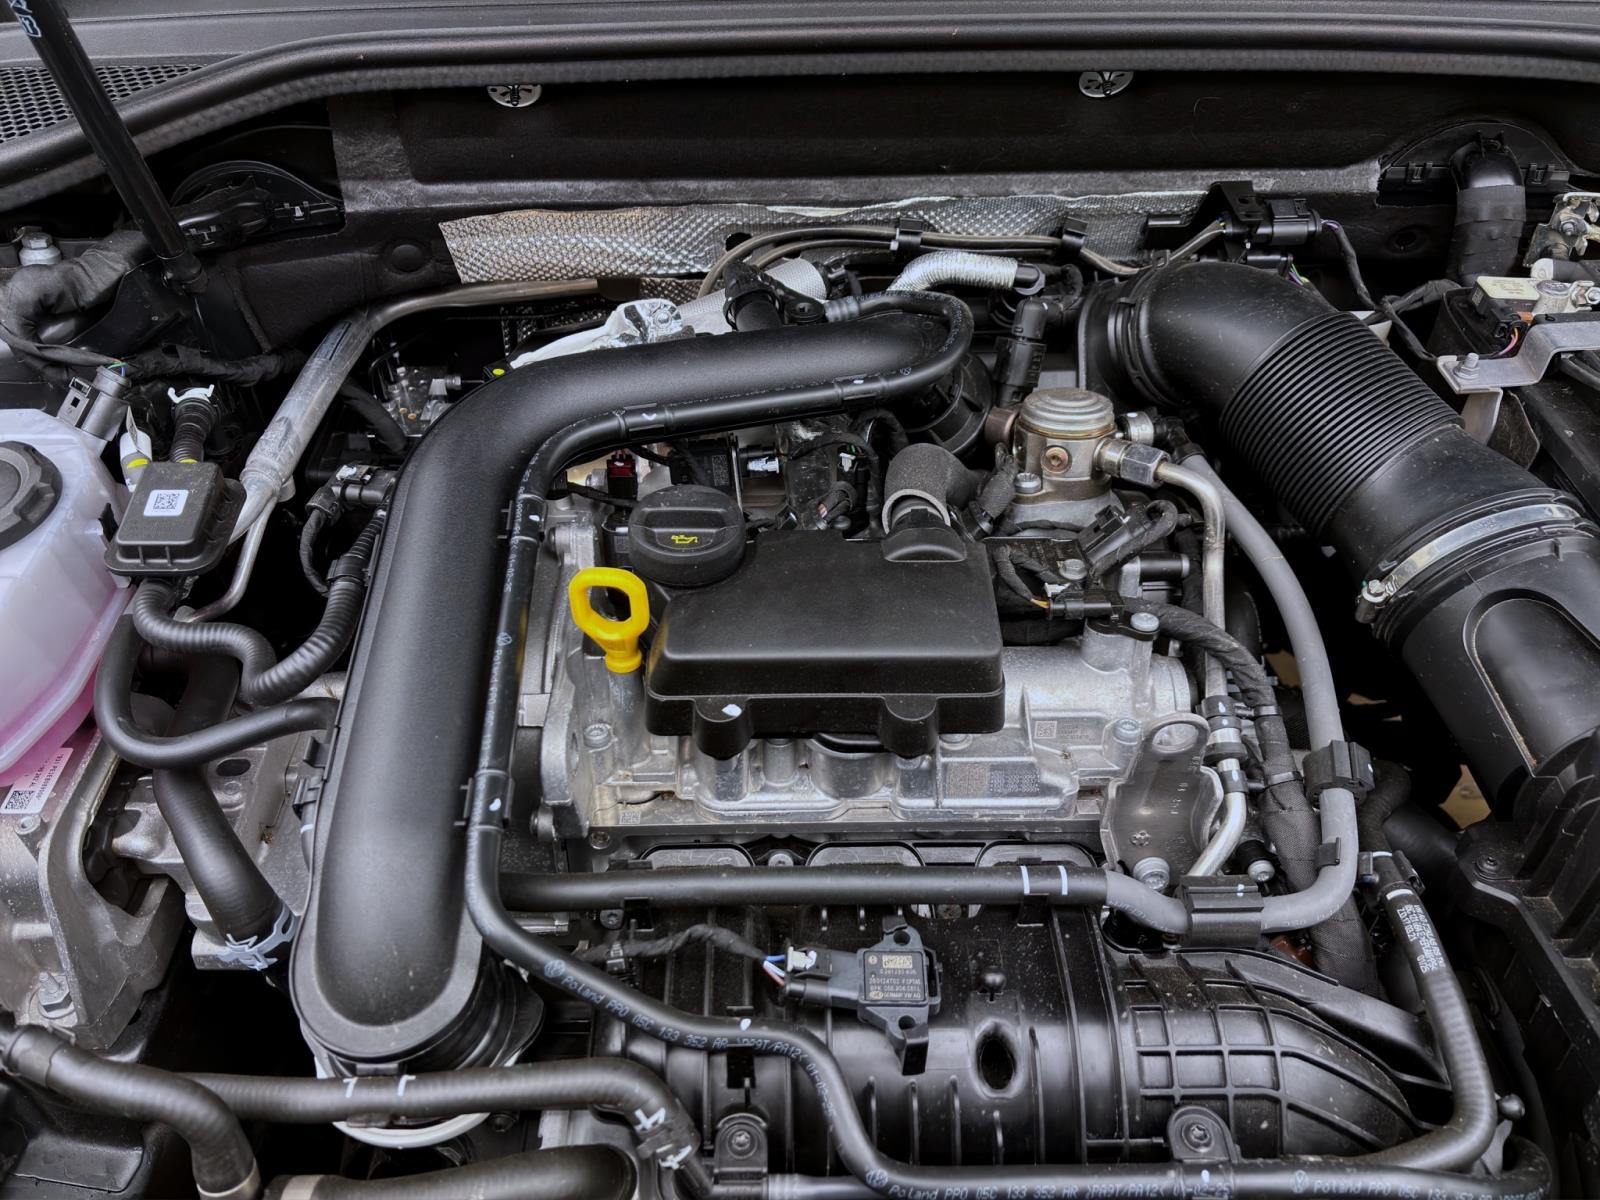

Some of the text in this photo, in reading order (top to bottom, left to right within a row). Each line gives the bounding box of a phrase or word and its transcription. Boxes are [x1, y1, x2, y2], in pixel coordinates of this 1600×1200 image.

[561, 975, 606, 1005] Poland
[659, 1026, 681, 1041] 133
[684, 1033, 709, 1048] 352
[888, 1184, 939, 1200] Poland
[1006, 1185, 1027, 1199] 133
[1033, 1185, 1057, 1199] 352
